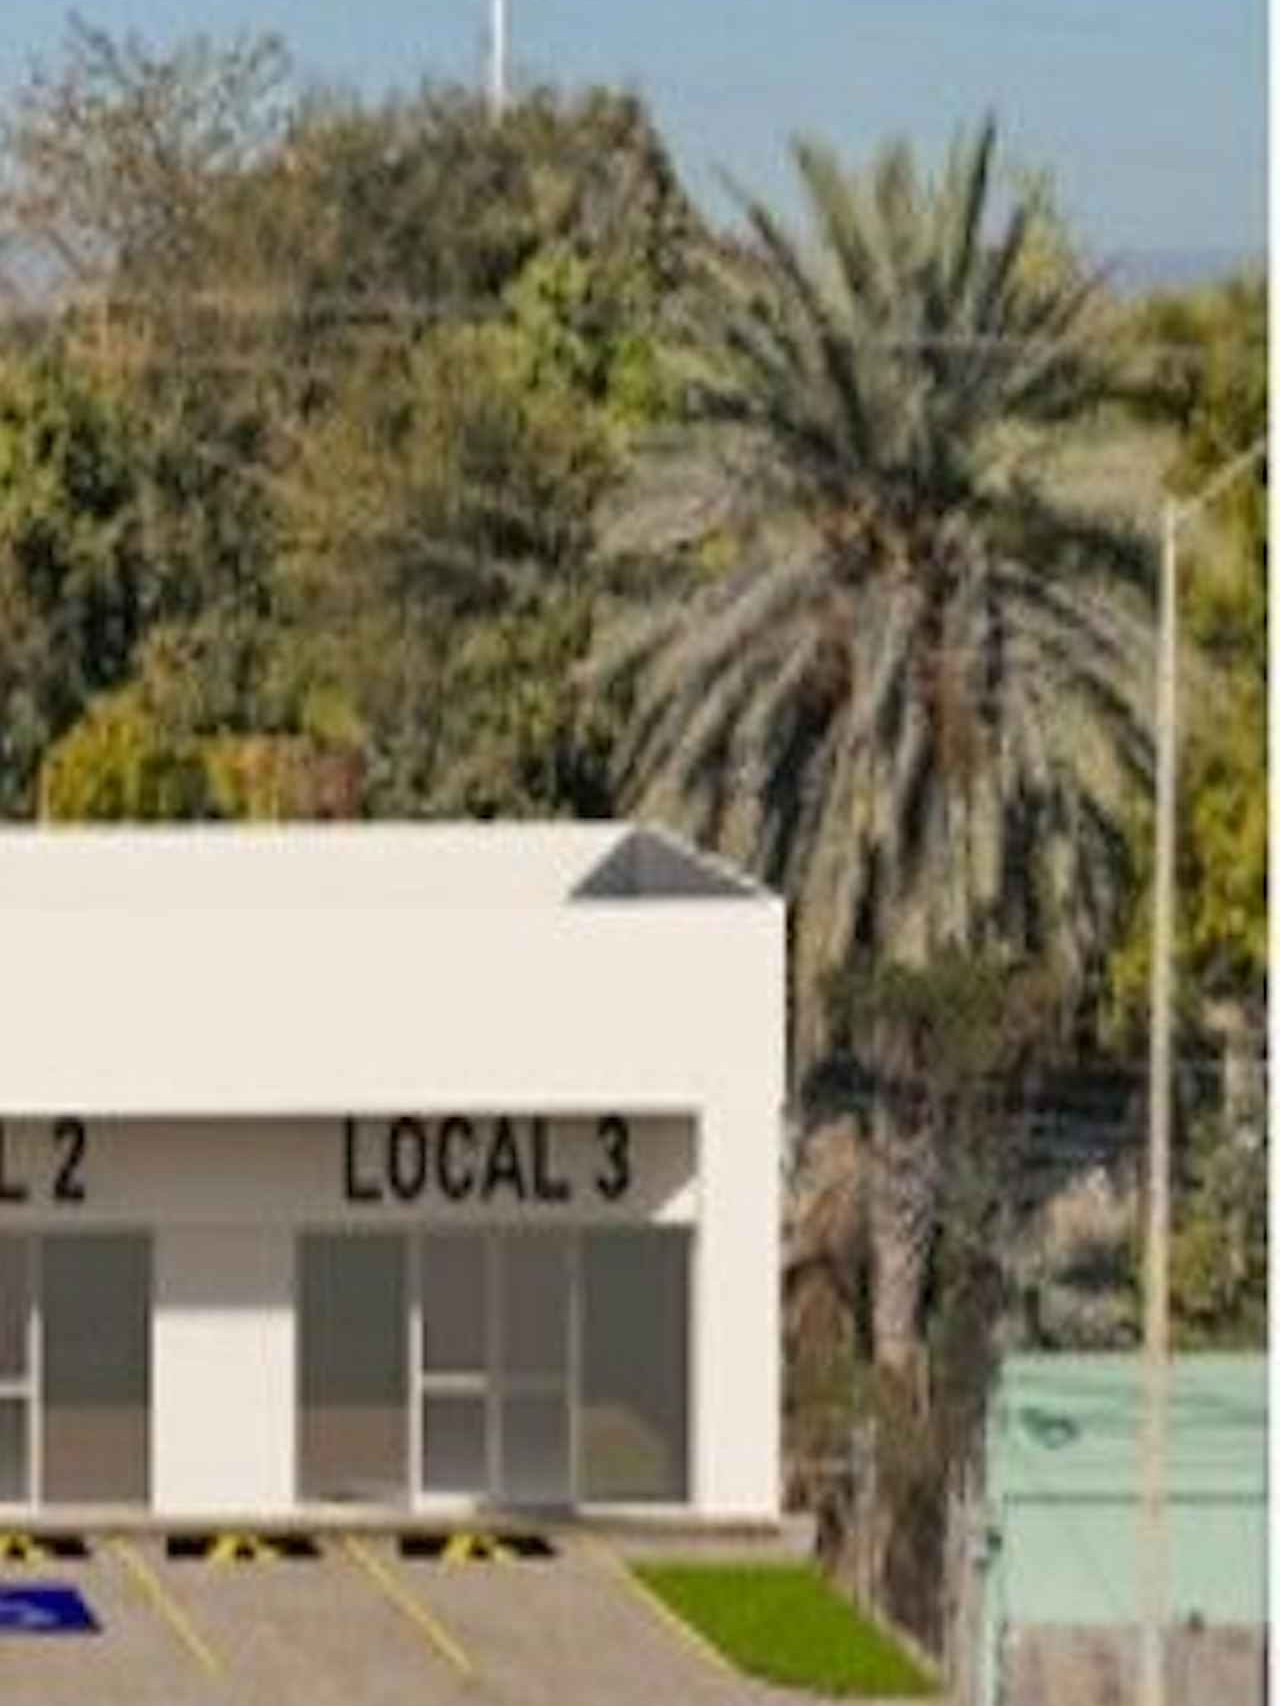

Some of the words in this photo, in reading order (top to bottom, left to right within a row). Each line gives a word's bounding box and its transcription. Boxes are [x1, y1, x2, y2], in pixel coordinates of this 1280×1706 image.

[52, 1117, 86, 1201] 2
[342, 1117, 568, 1202] LOCAL
[595, 1117, 630, 1201] 3
